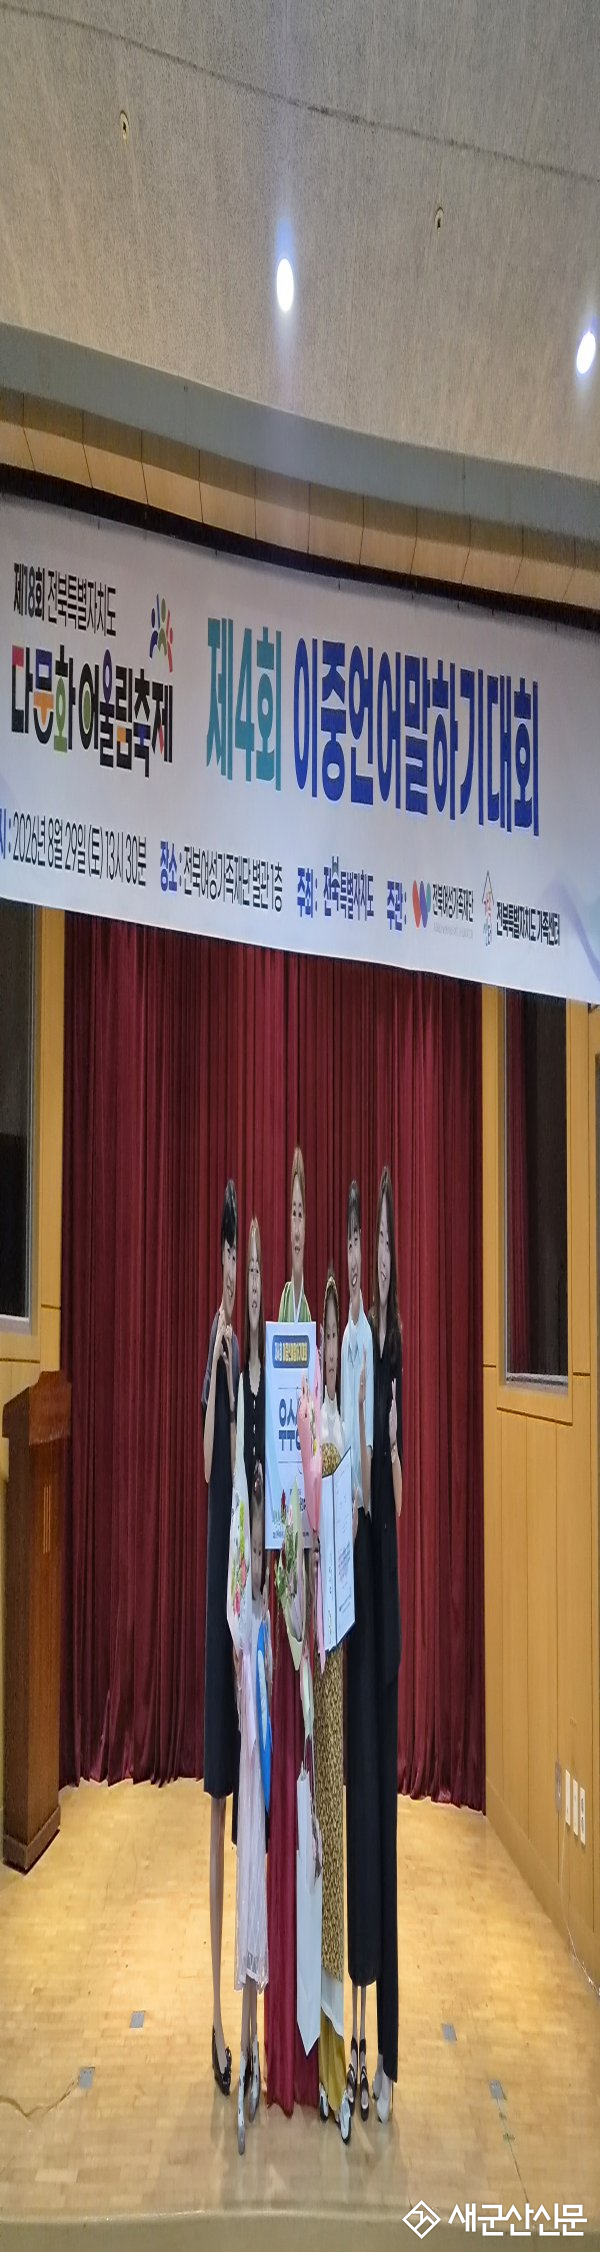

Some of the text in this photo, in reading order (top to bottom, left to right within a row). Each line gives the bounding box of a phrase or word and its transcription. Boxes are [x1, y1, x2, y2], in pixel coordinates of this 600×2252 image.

[13, 563, 117, 636] 제18회 전북특별자치도
[11, 644, 173, 778] 다문화 어울림축제
[206, 617, 539, 836] 제4회 이중언어말하기대회
[13, 811, 46, 866] 2026년
[48, 817, 63, 869] 8월
[105, 830, 124, 882] 13시
[126, 833, 147, 886] 30분
[184, 846, 251, 906] 전북여성가족재단
[252, 858, 269, 909] 별관
[270, 861, 283, 912] 1층
[323, 856, 375, 921] 전북특별자치도
[432, 883, 474, 922] 전북여성가족재단
